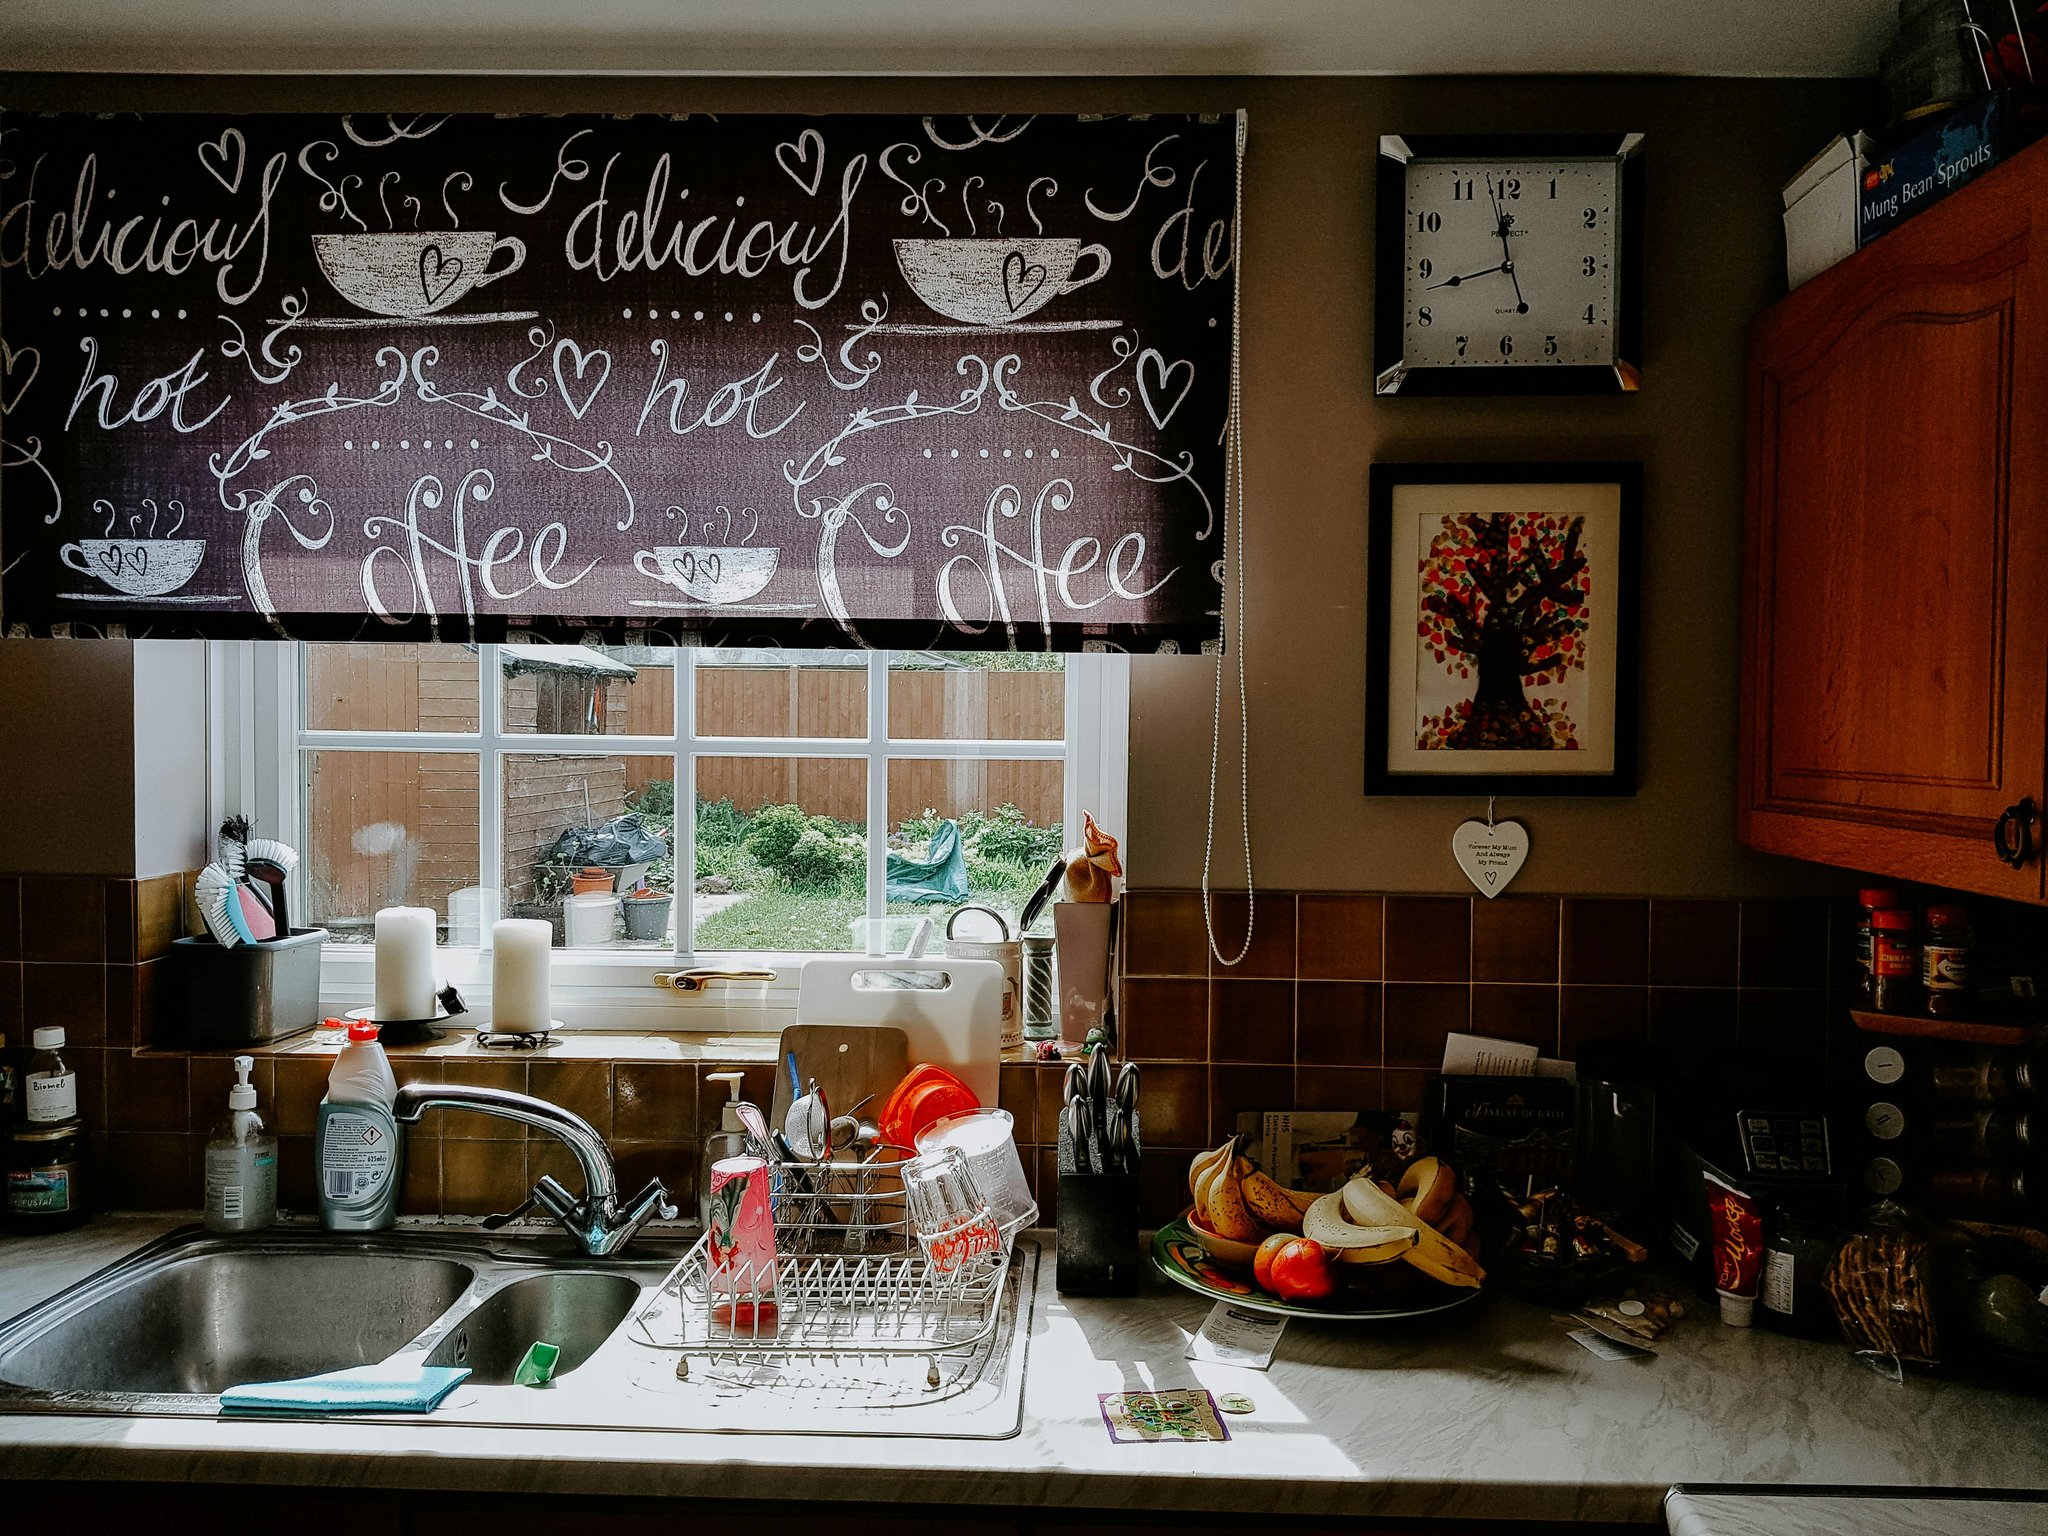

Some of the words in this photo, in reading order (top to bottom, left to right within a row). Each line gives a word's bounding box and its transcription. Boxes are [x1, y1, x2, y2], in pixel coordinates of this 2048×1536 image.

[1453, 179, 1474, 200] 11
[1497, 179, 1521, 200] 12
[1548, 178, 1558, 199] 1
[1863, 194, 1898, 224] Mung
[1902, 175, 1933, 205] Bean
[1937, 143, 1992, 188] Sprouts
[1417, 212, 1441, 232] 10
[1583, 208, 1596, 229] 2
[565, 150, 869, 309] delicious
[1151, 159, 1235, 291] de
[1419, 258, 1433, 279] 9
[1582, 256, 1596, 277] 3
[1418, 306, 1432, 327] 8
[1582, 304, 1595, 325] 4
[1456, 336, 1469, 357] 7
[1500, 336, 1512, 356] 6
[1544, 336, 1558, 356] 5
[64, 337, 229, 433] hot
[636, 339, 807, 439] hot
[239, 469, 605, 642] Coffee
[816, 478, 1179, 651] Coffee
[33, 1079, 66, 1091] Biomel
[1282, 1115, 1290, 1133] NHS
